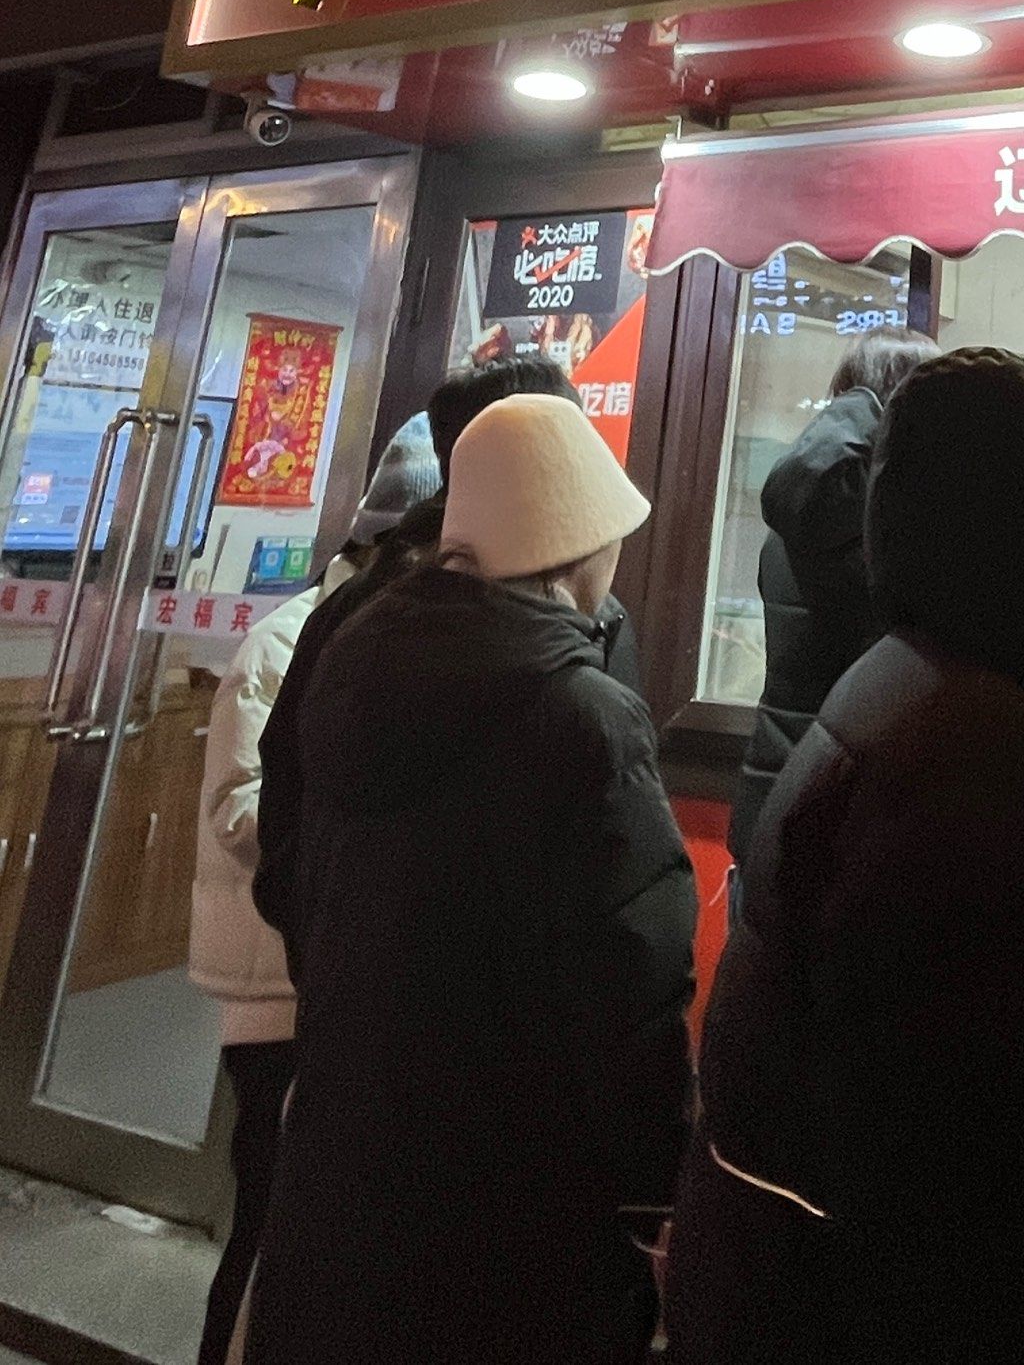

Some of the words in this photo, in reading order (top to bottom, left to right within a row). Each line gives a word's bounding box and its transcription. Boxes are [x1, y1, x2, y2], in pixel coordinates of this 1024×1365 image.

[537, 221, 600, 246] 大众点评
[527, 285, 574, 309] 2020
